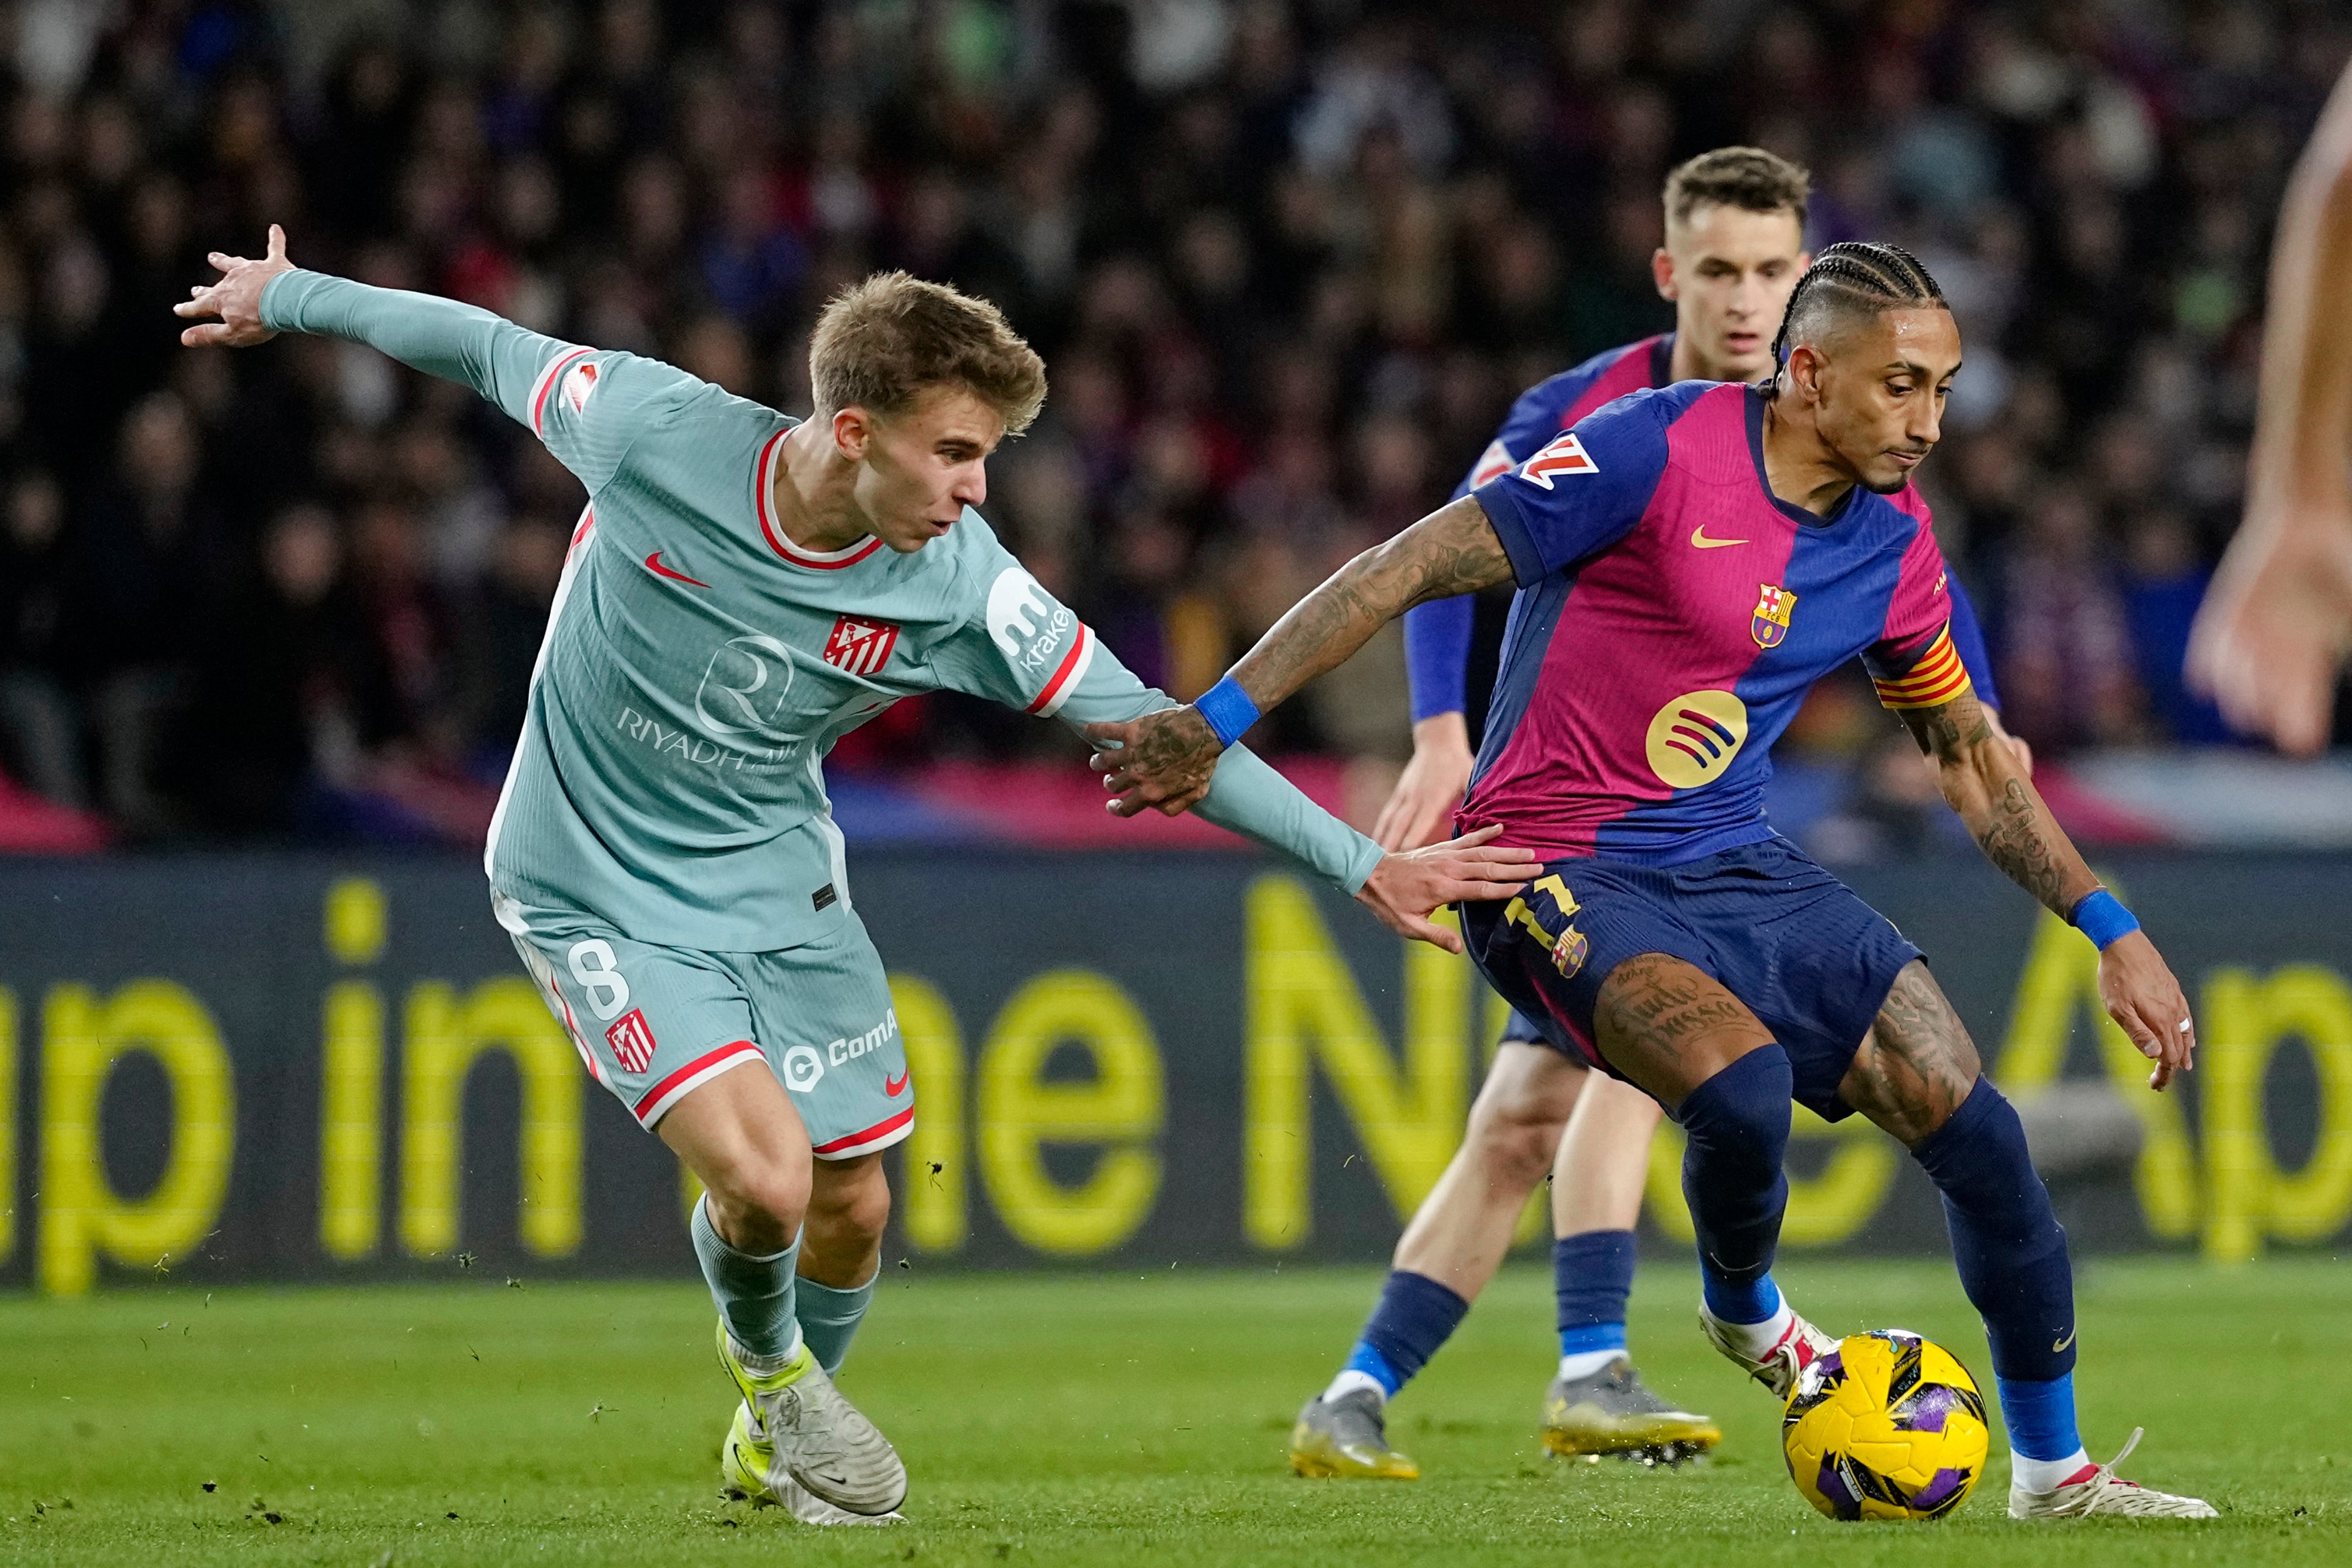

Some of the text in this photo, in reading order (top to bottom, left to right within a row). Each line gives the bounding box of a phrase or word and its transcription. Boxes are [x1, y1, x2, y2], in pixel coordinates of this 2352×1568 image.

[1765, 611, 1781, 623] FCB
[617, 706, 749, 771] RIYADH
[1504, 873, 1582, 953] 11
[567, 938, 631, 1022] 8
[0, 978, 236, 1295] p
[320, 877, 584, 1260] in
